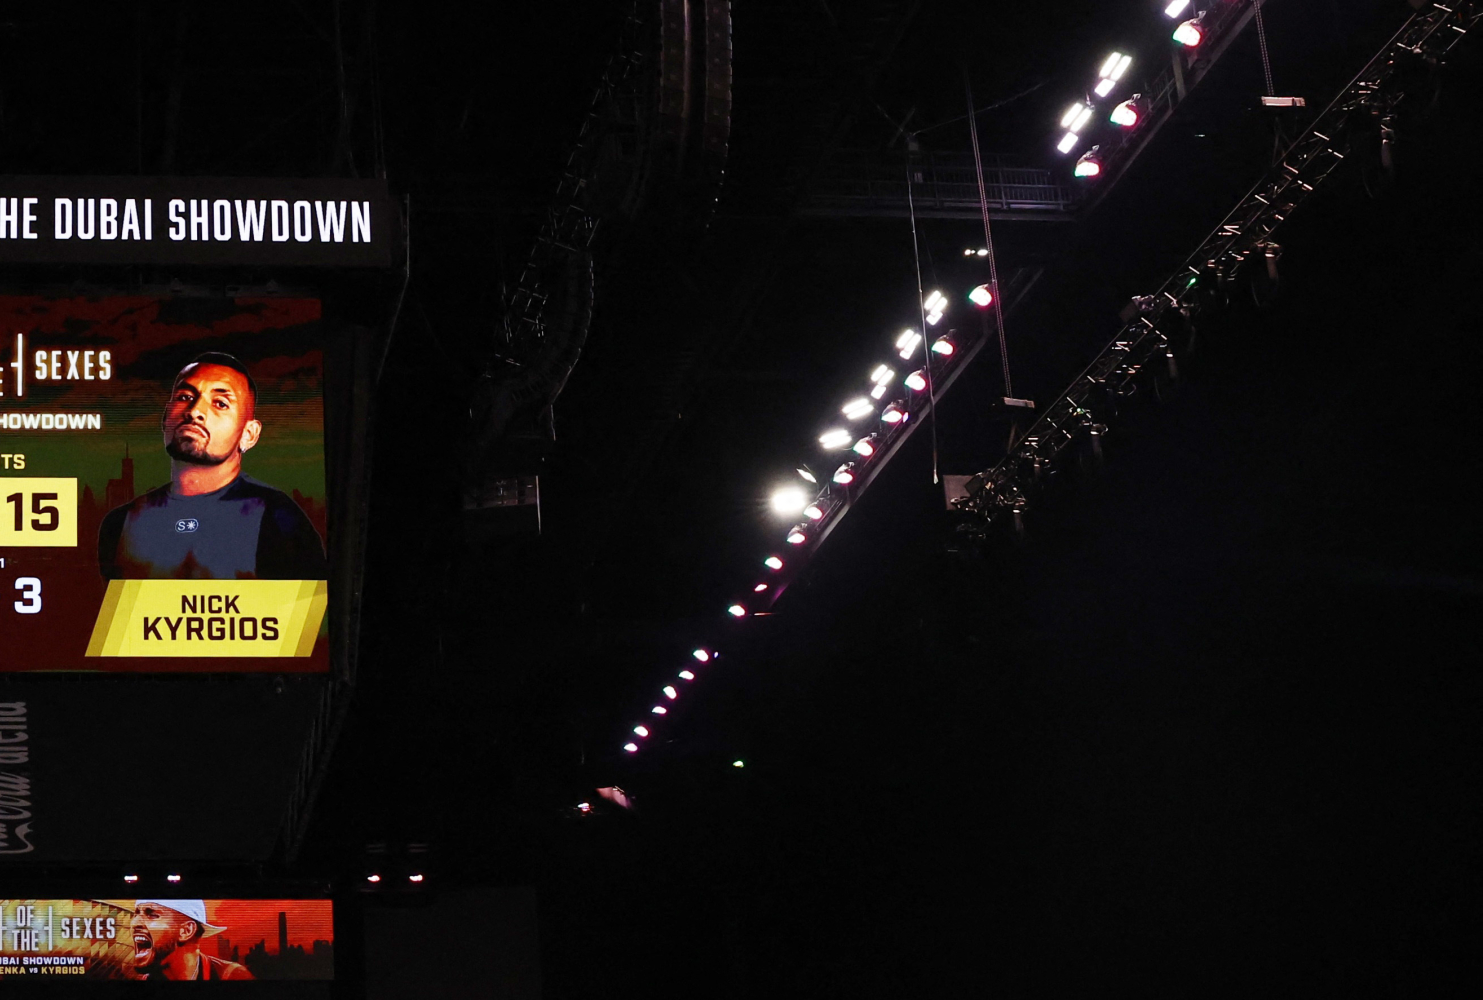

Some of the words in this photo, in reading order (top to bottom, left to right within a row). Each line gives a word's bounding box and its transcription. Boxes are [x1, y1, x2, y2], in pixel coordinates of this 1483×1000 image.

[54, 197, 152, 241] DUBAI
[168, 198, 371, 243] SHOWDOWN
[35, 350, 111, 380] SEXES
[6, 492, 60, 532] 15
[0, 557, 5, 569] 1
[14, 576, 42, 614] 3
[181, 594, 241, 614] NICK
[143, 616, 279, 641] KYRGIOS
[16, 905, 35, 926] OF
[61, 918, 116, 939] SEXES
[12, 930, 40, 951] THE
[22, 956, 84, 965] SHOWDOWN
[41, 966, 85, 975] KYRGIOS
